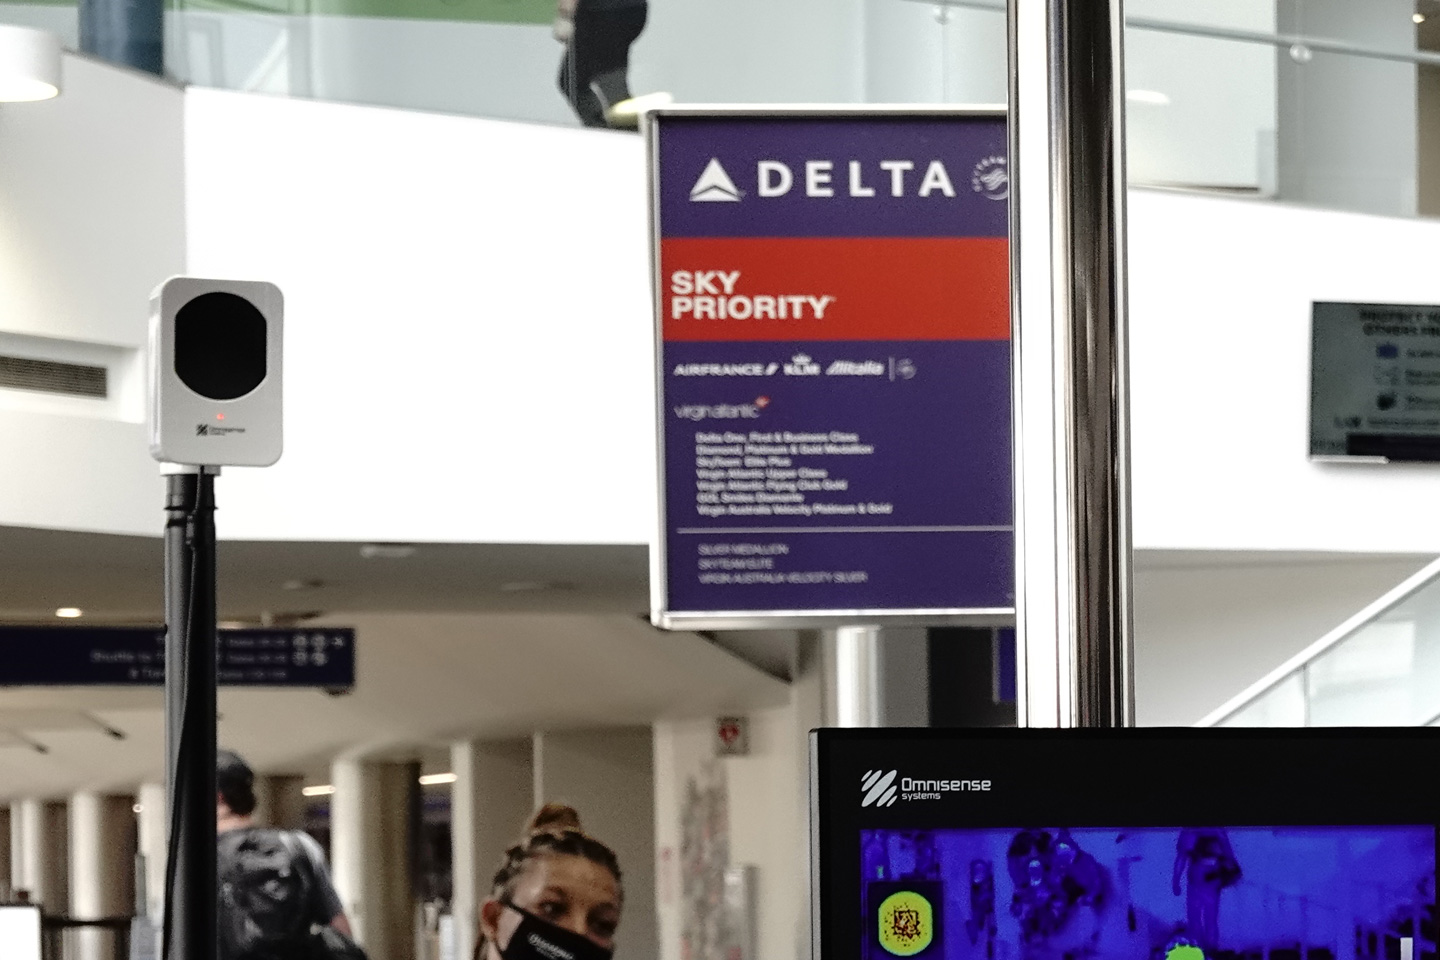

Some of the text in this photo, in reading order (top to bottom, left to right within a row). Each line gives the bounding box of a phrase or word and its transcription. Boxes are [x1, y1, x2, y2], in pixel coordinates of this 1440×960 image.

[758, 160, 956, 197] DELTA
[671, 270, 741, 294] SKY
[671, 296, 831, 319] PRIORITY
[901, 777, 992, 792] Omnisense
[901, 792, 941, 801] systems
